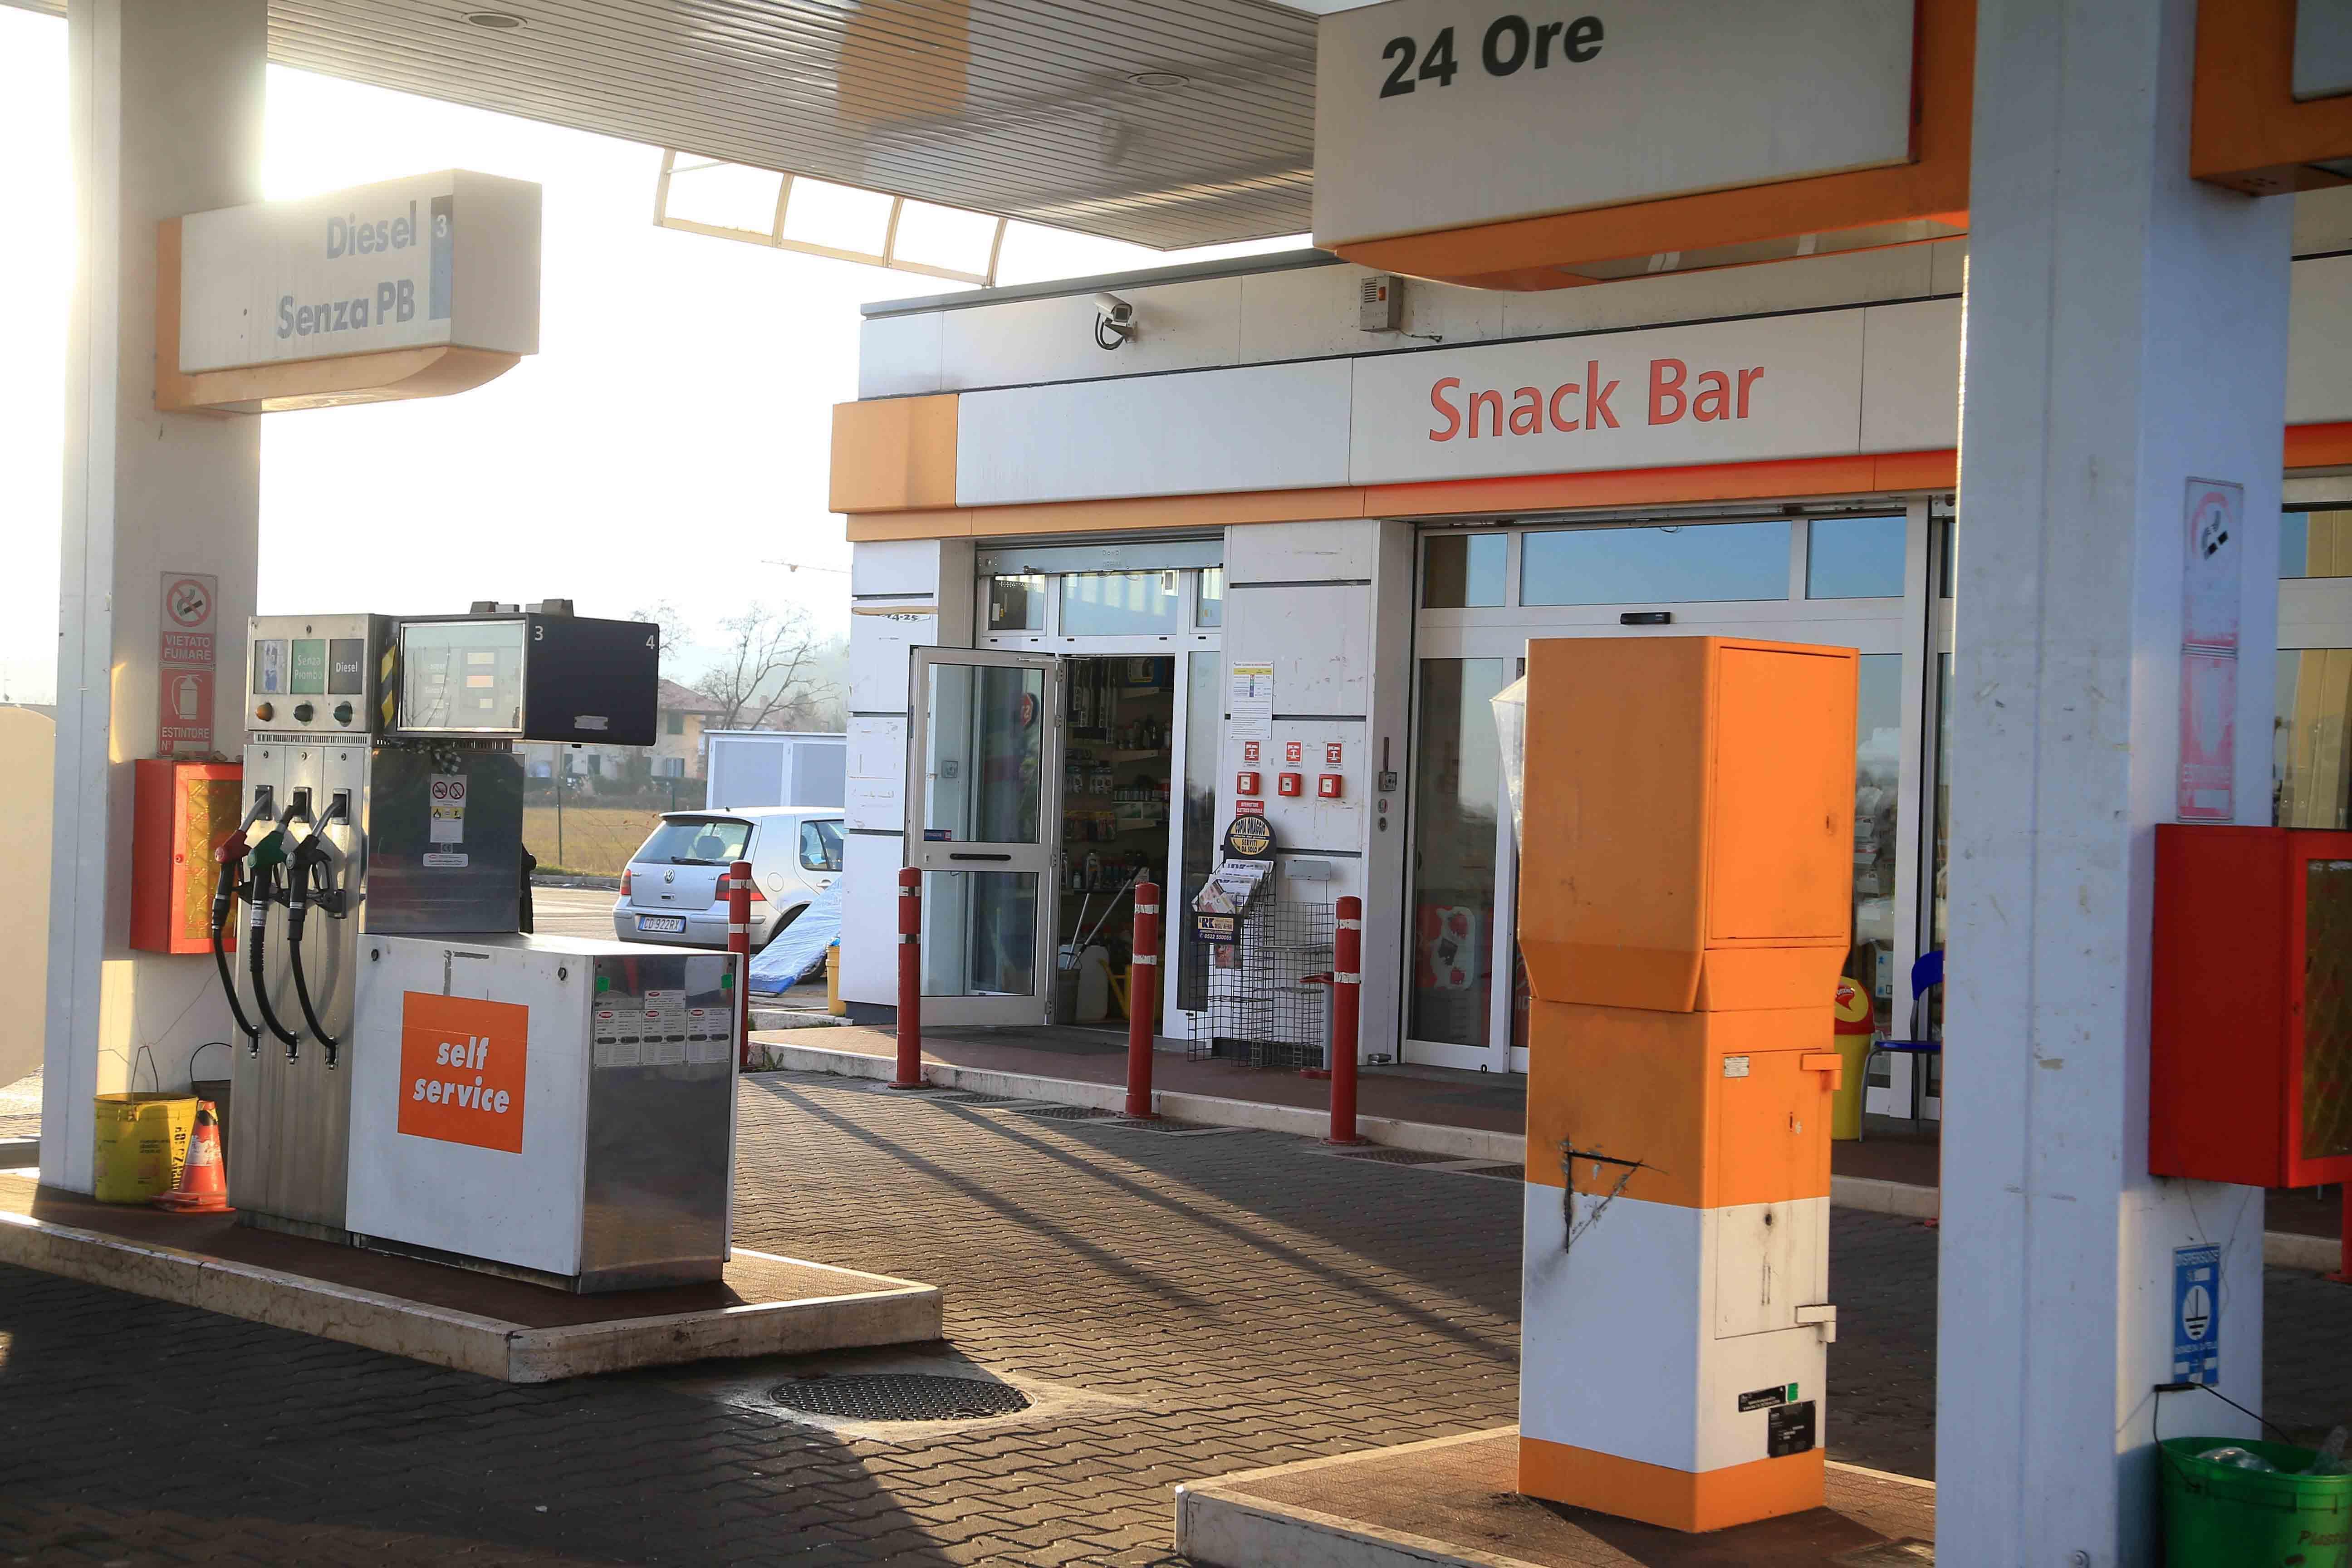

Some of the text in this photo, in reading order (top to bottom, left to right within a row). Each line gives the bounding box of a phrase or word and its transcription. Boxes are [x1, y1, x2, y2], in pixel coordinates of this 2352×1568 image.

[1380, 15, 1604, 98] 24 Ore
[326, 200, 417, 260] Diesel
[436, 215, 447, 238] 3
[277, 279, 416, 339] Senza PB
[1429, 358, 1764, 442] Snack Bar
[166, 635, 211, 647] VIETATO
[534, 625, 544, 641] 3
[646, 635, 655, 650] 4
[165, 647, 211, 660] FUMARE
[297, 655, 321, 666] Senza
[294, 669, 323, 679] Piombo
[336, 662, 358, 673] Diesel
[162, 727, 210, 739] ESTINTORE
[1235, 817, 1265, 835] COPIA OMAGGIO
[656, 919, 680, 930] 922RX
[436, 1036, 490, 1070] self
[412, 1076, 510, 1114] service
